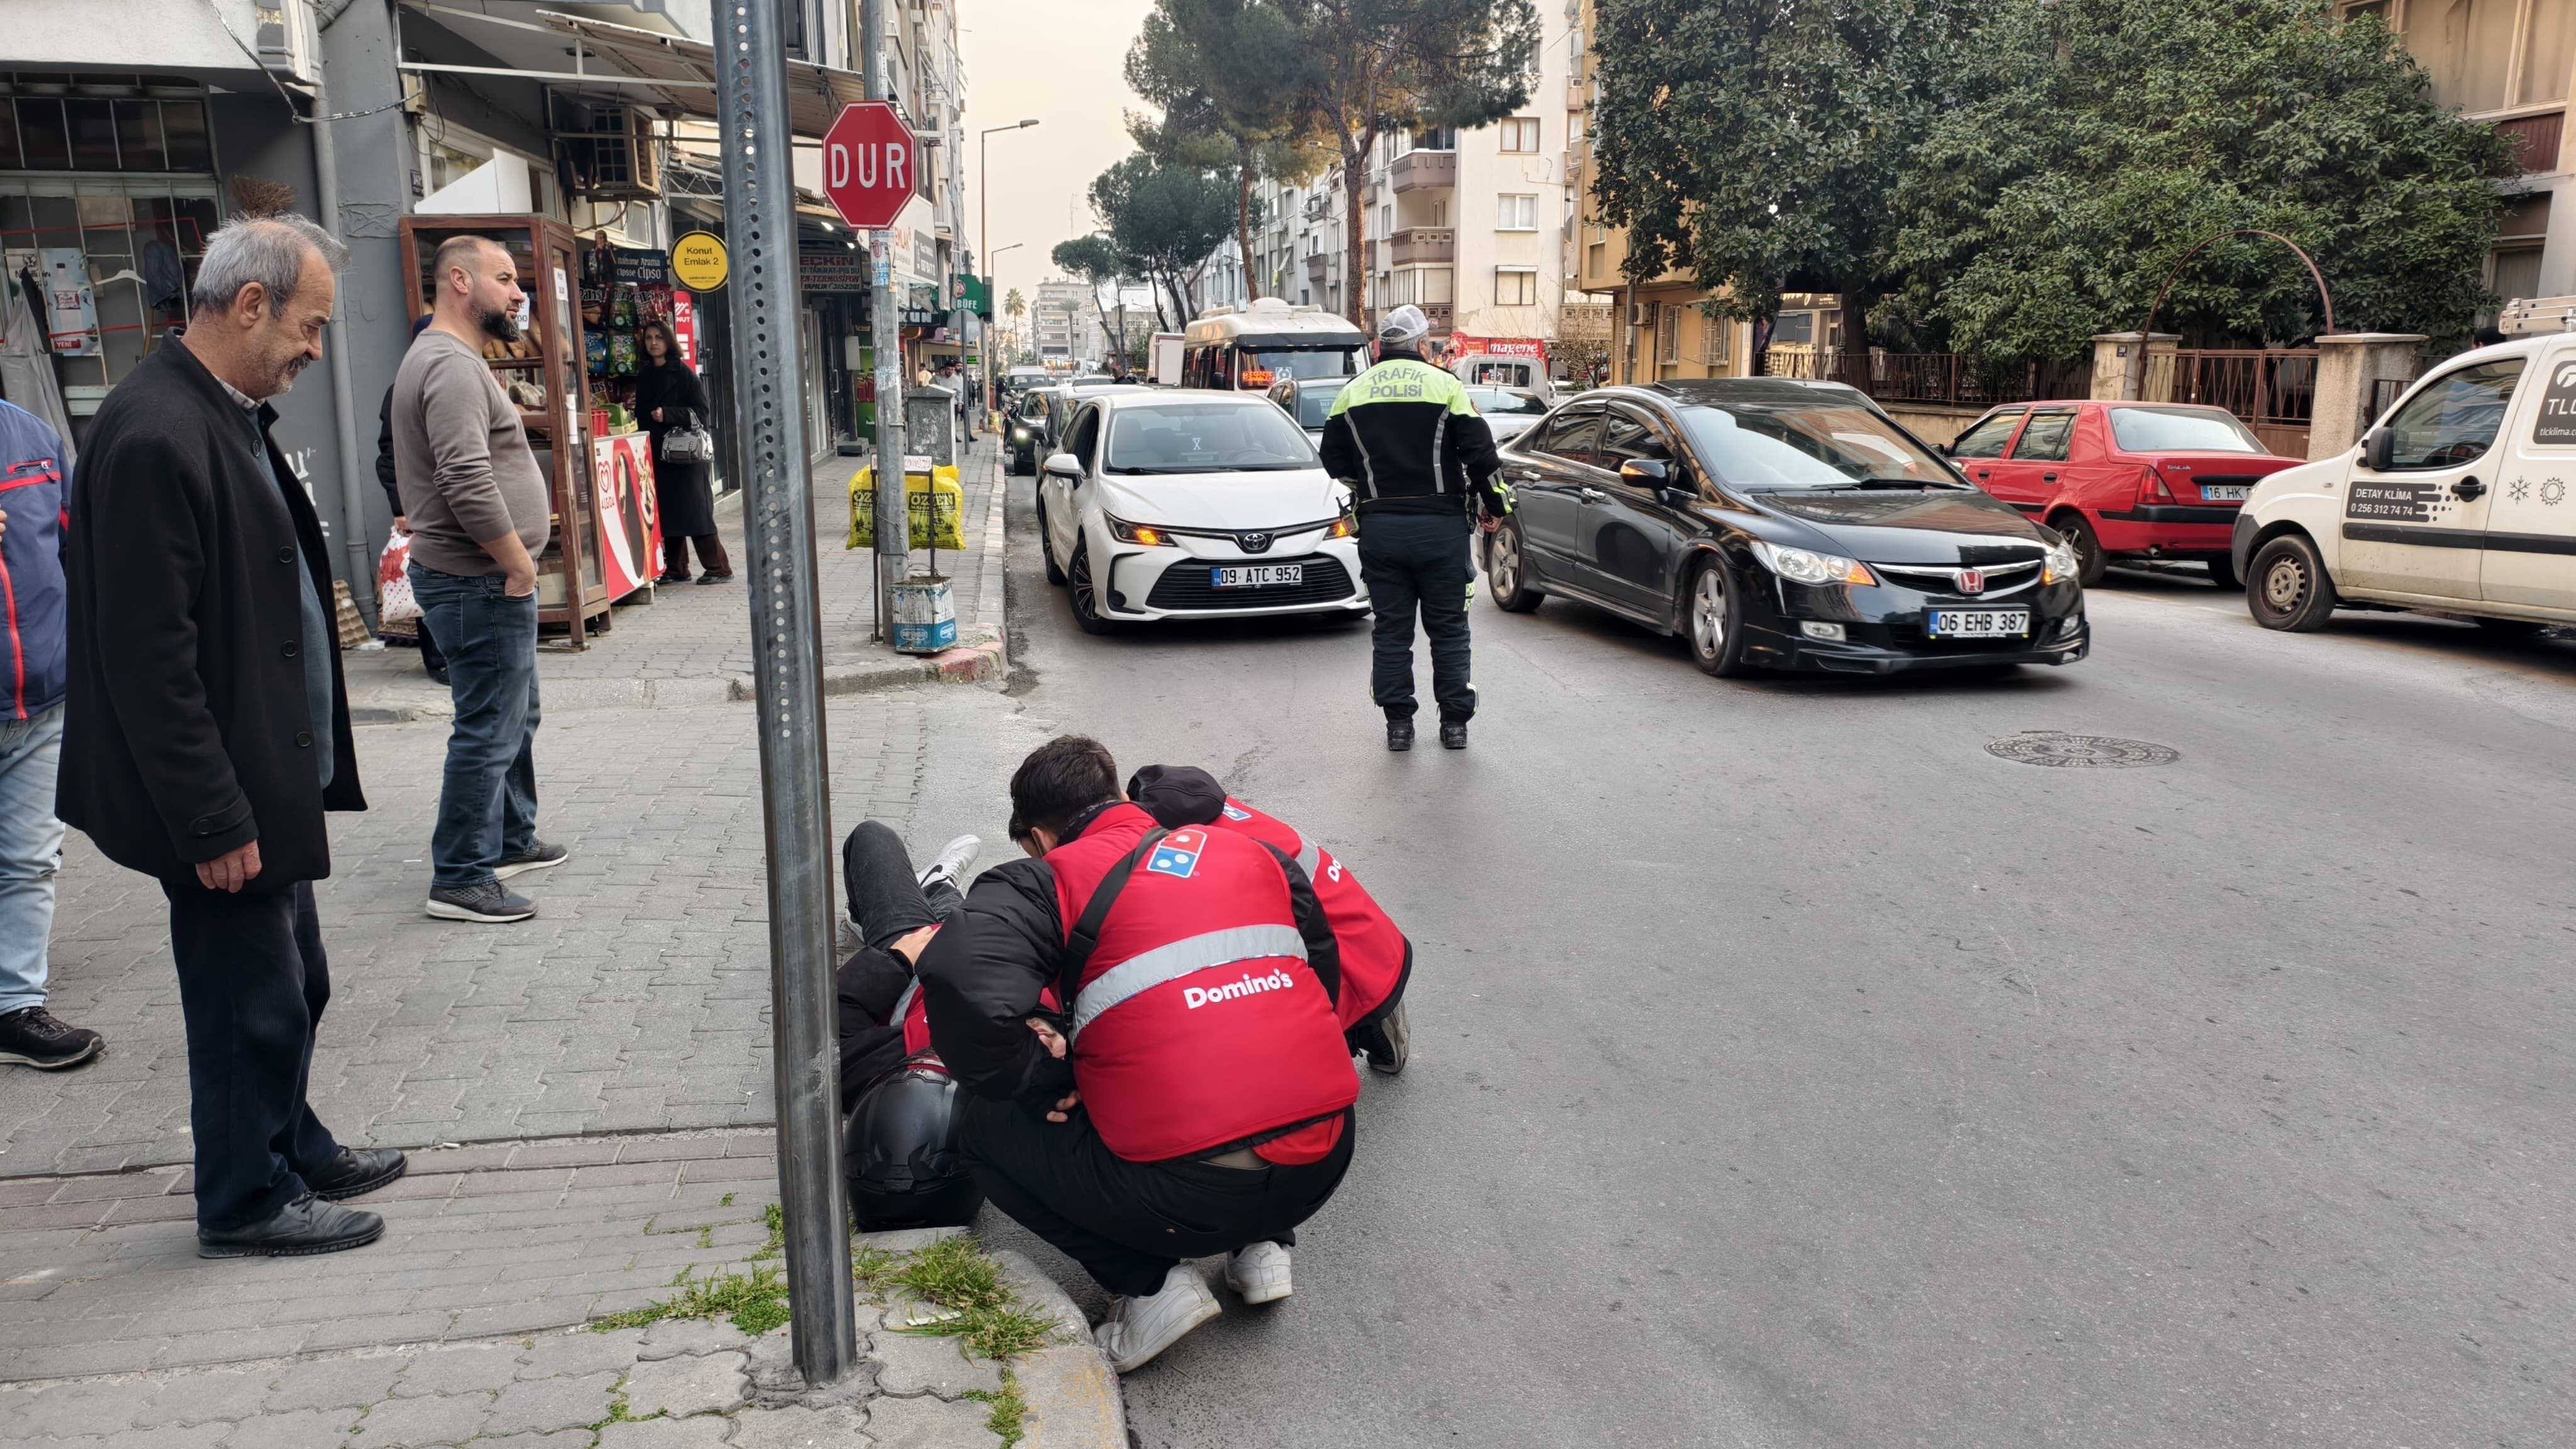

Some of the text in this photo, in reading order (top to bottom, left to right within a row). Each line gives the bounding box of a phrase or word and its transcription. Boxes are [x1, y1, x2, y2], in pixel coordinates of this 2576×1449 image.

[831, 143, 906, 188] DUR
[686, 247, 713, 255] Konut
[640, 257, 661, 267] Arama
[713, 257, 719, 265] 2
[799, 256, 854, 267] EÇKİN
[957, 298, 977, 309] BÜFE
[1369, 384, 1423, 399] POLİSİ
[2209, 487, 2243, 499] 16 HK
[2355, 488, 2412, 501] DETAY KLİMA
[2351, 503, 2413, 516] 0 256 312 74 74
[1221, 570, 1236, 584] 09
[1246, 568, 1270, 583] ATC
[1276, 567, 1300, 582] 952
[1939, 614, 1958, 631] 06
[1965, 614, 1993, 631] EHB
[1999, 613, 2027, 631] 387
[1183, 968, 1294, 1009] Domino's
